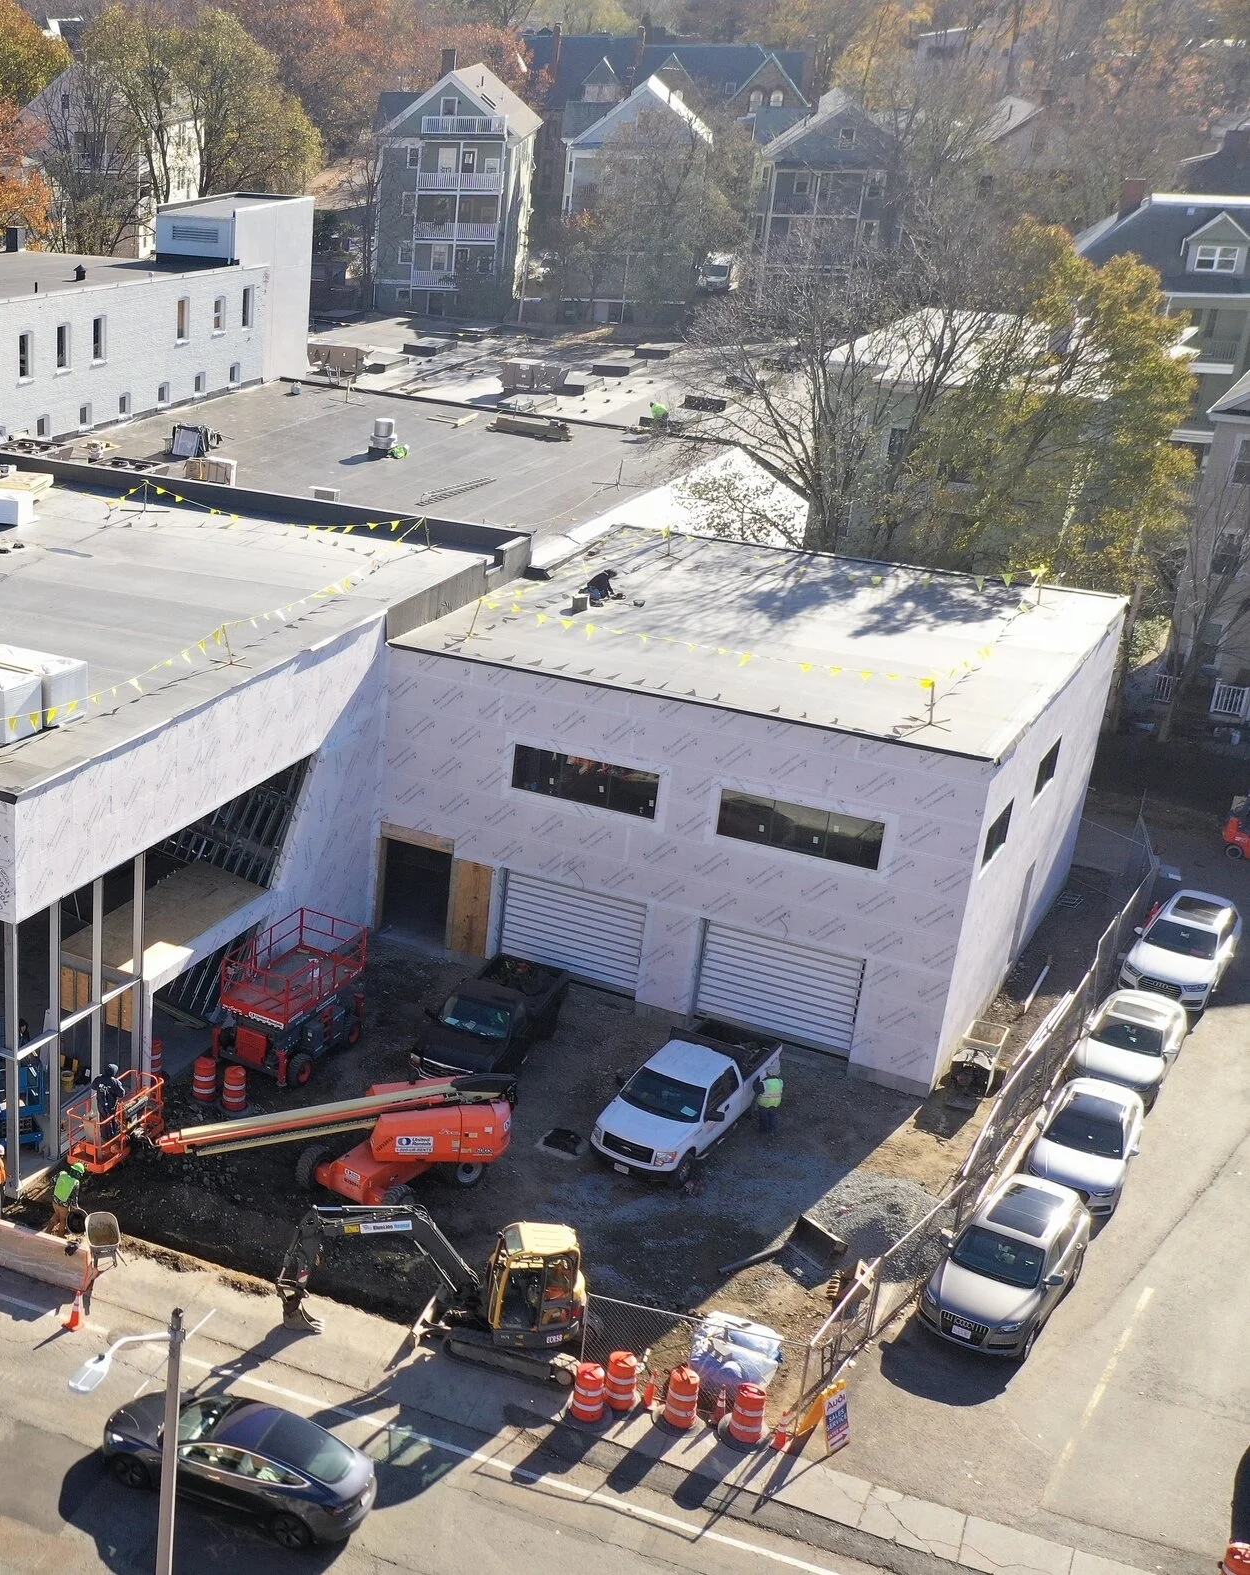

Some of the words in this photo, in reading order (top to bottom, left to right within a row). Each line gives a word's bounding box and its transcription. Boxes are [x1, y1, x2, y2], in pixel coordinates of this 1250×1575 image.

[827, 1394, 846, 1411] Audi
[827, 1413, 847, 1431] SERVICE
[829, 1408, 844, 1421] SALES
